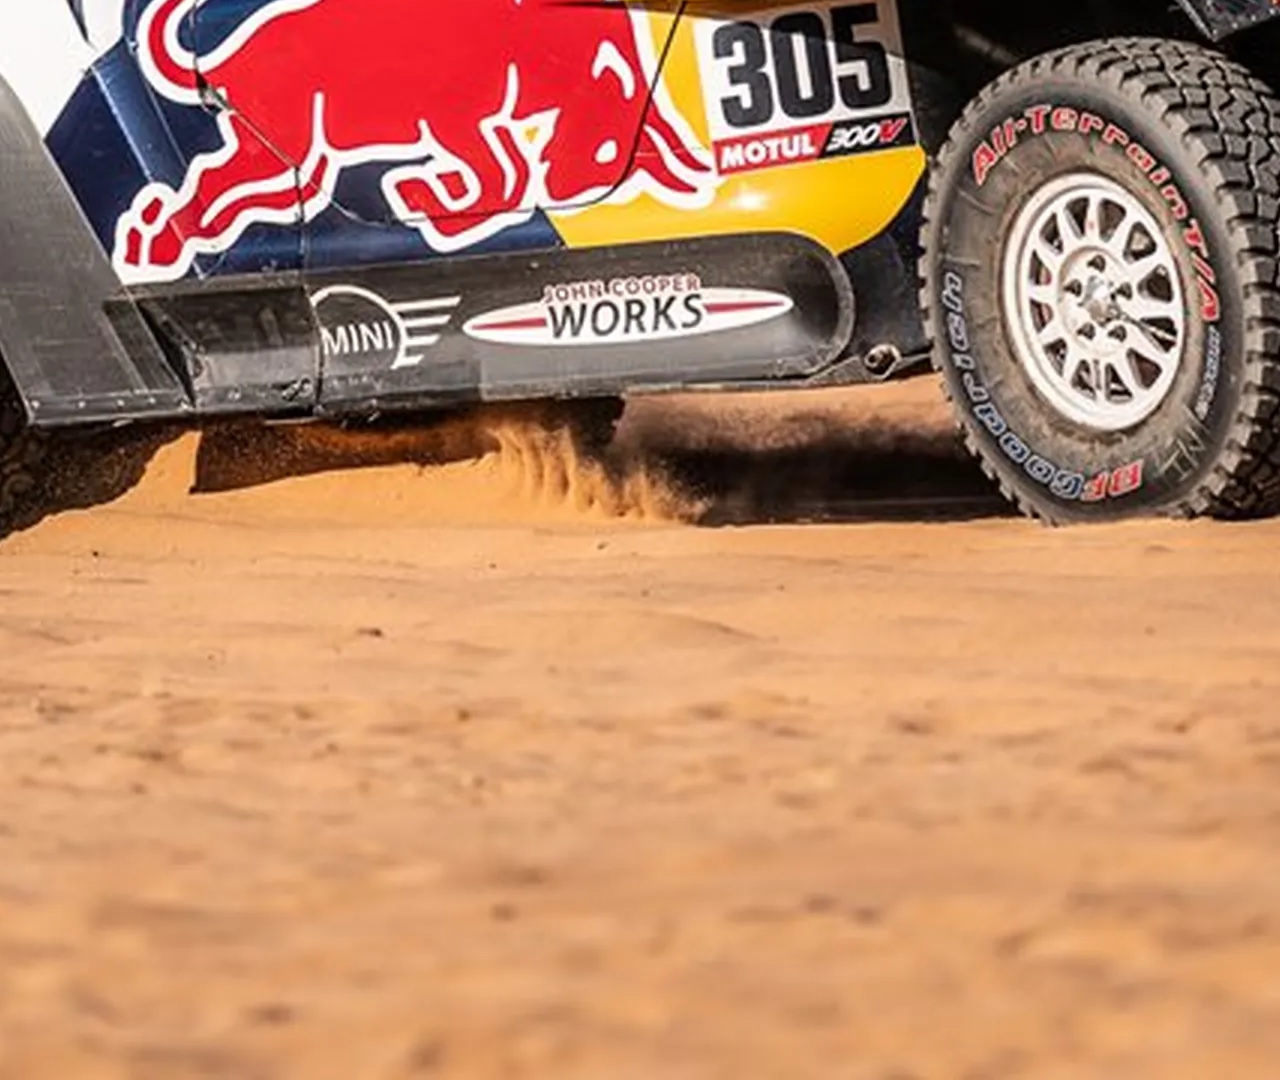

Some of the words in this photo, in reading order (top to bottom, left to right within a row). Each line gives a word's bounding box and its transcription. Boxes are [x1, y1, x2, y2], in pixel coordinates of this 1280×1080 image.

[712, 3, 893, 128] 305
[721, 134, 816, 170] MOTUL
[825, 118, 908, 152] 300V
[543, 281, 602, 304] JOHN
[608, 273, 701, 296] COOPER
[321, 323, 394, 356] MINI
[547, 294, 704, 340] WORKS
